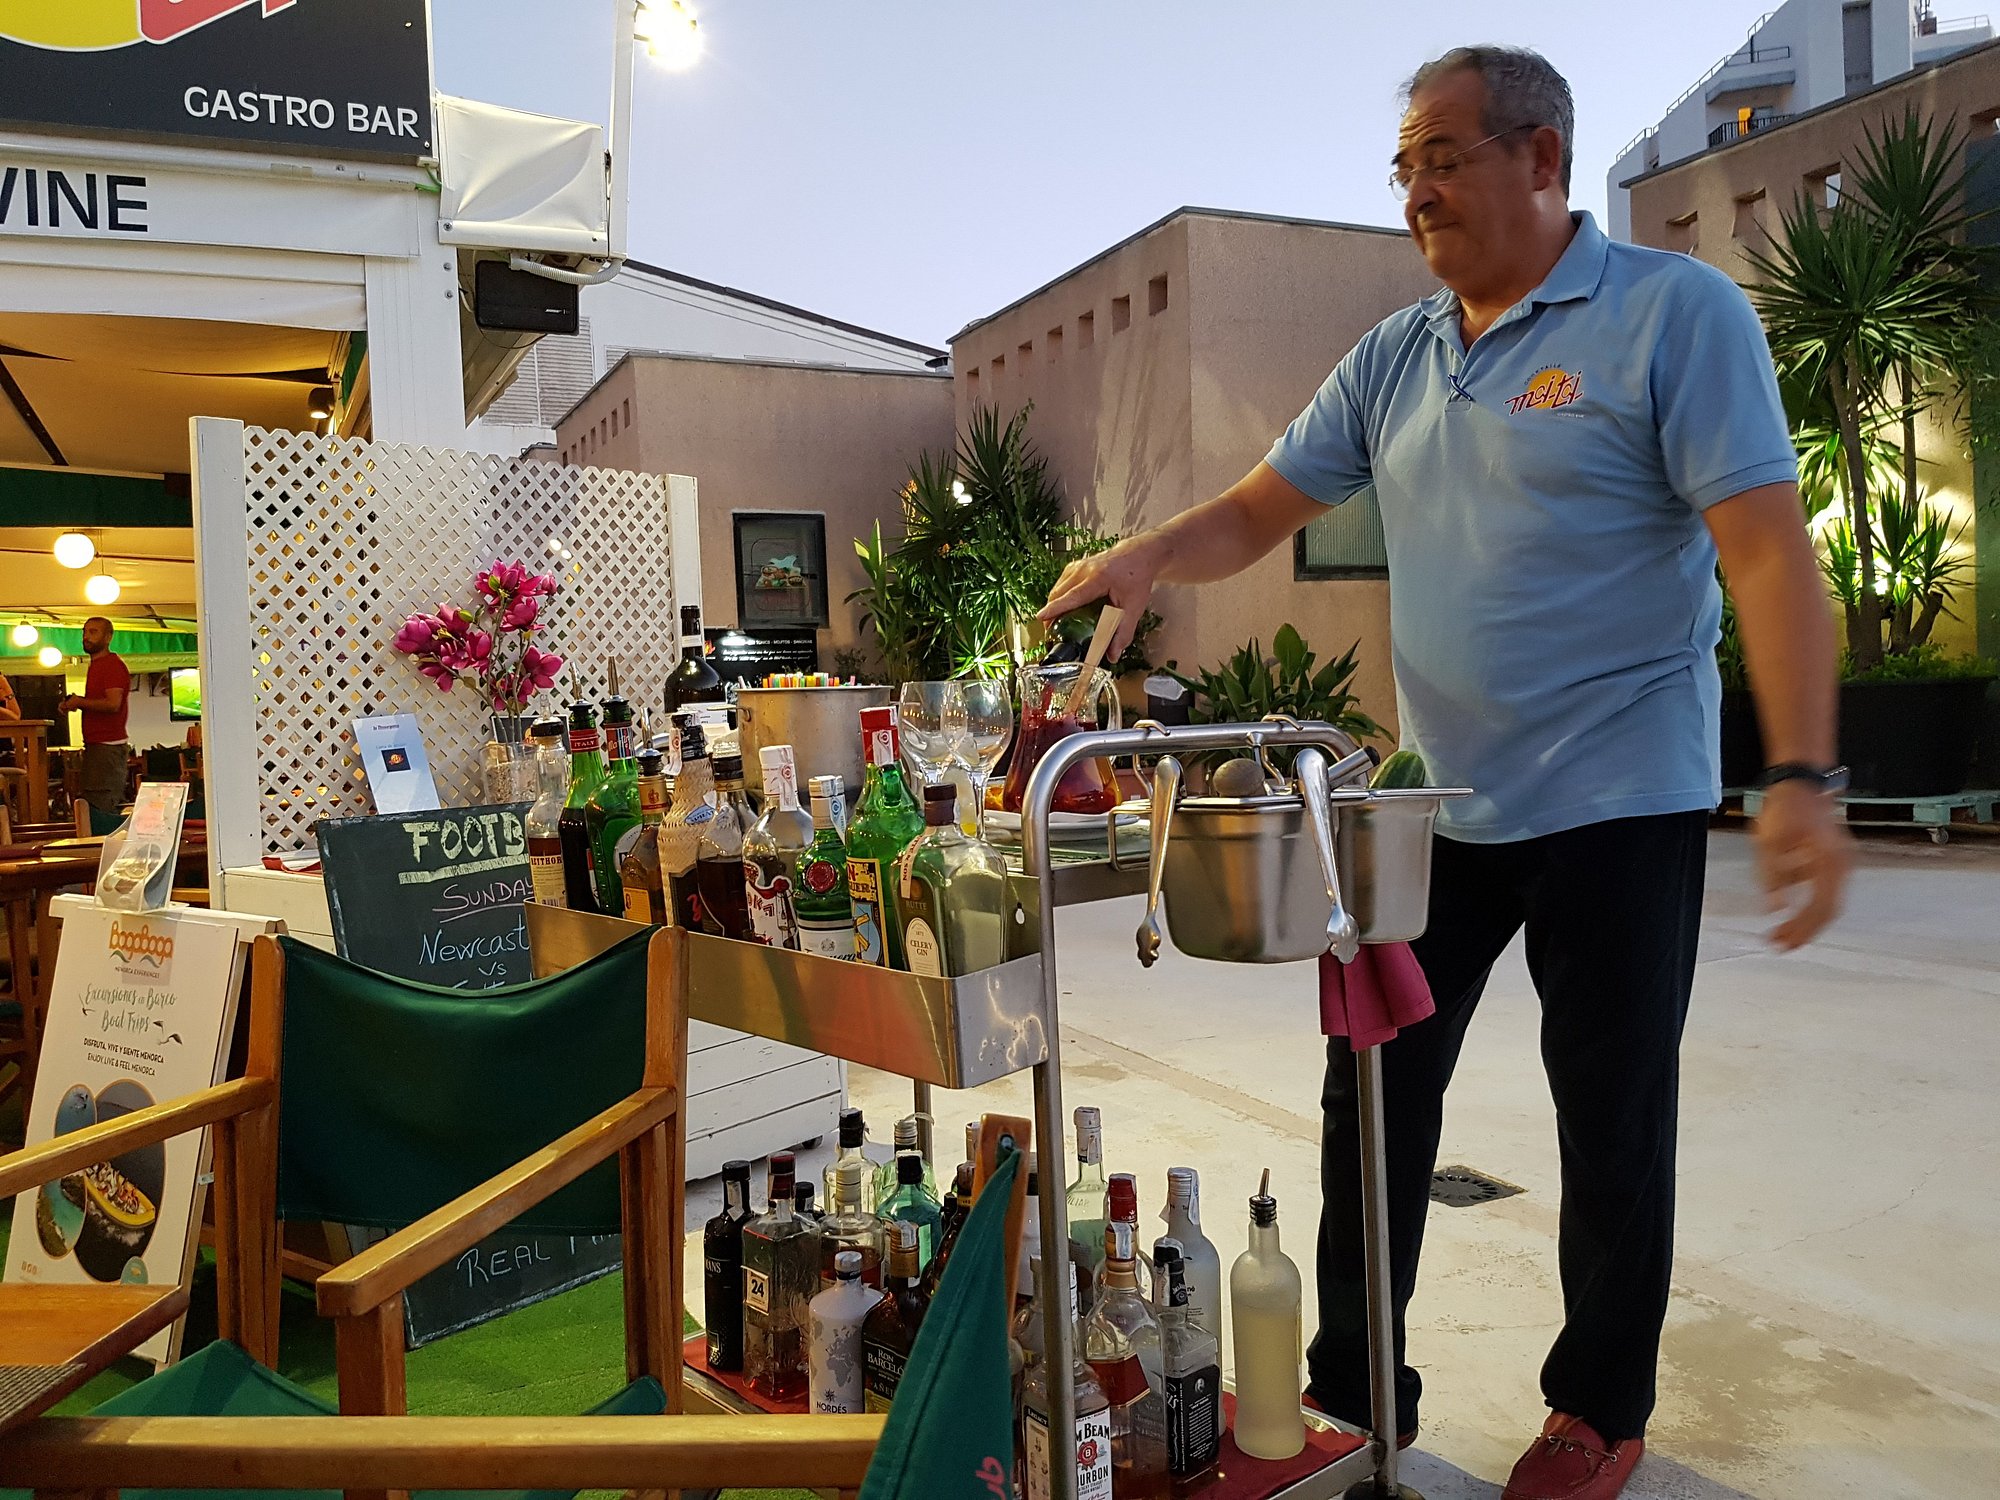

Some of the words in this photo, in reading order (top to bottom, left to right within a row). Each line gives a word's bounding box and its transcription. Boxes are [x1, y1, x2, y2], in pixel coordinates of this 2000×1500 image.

[184, 86, 335, 130] GASTRO
[347, 102, 419, 138] BAR
[443, 876, 534, 910] SUNDAY
[418, 914, 531, 966] Newcast
[910, 940, 933, 950] CELERY
[916, 949, 928, 957] GIN
[146, 987, 177, 1011] Barco
[101, 1009, 125, 1032] Boat
[127, 1011, 149, 1035] Trips
[107, 1043, 119, 1053] VIVE
[123, 1047, 140, 1058] SIENTE
[140, 1051, 164, 1064] MENORCA
[104, 1056, 115, 1066] LIVE
[120, 1060, 131, 1071] FEEL
[131, 1063, 155, 1076] MENORCA
[456, 1240, 551, 1288] REAL
[751, 1278, 765, 1298] 24
[867, 1352, 905, 1376] BARCELÓ
[877, 1349, 894, 1362] RON
[816, 1401, 847, 1414] NORDÉS
[1084, 1422, 1110, 1441] BEAM
